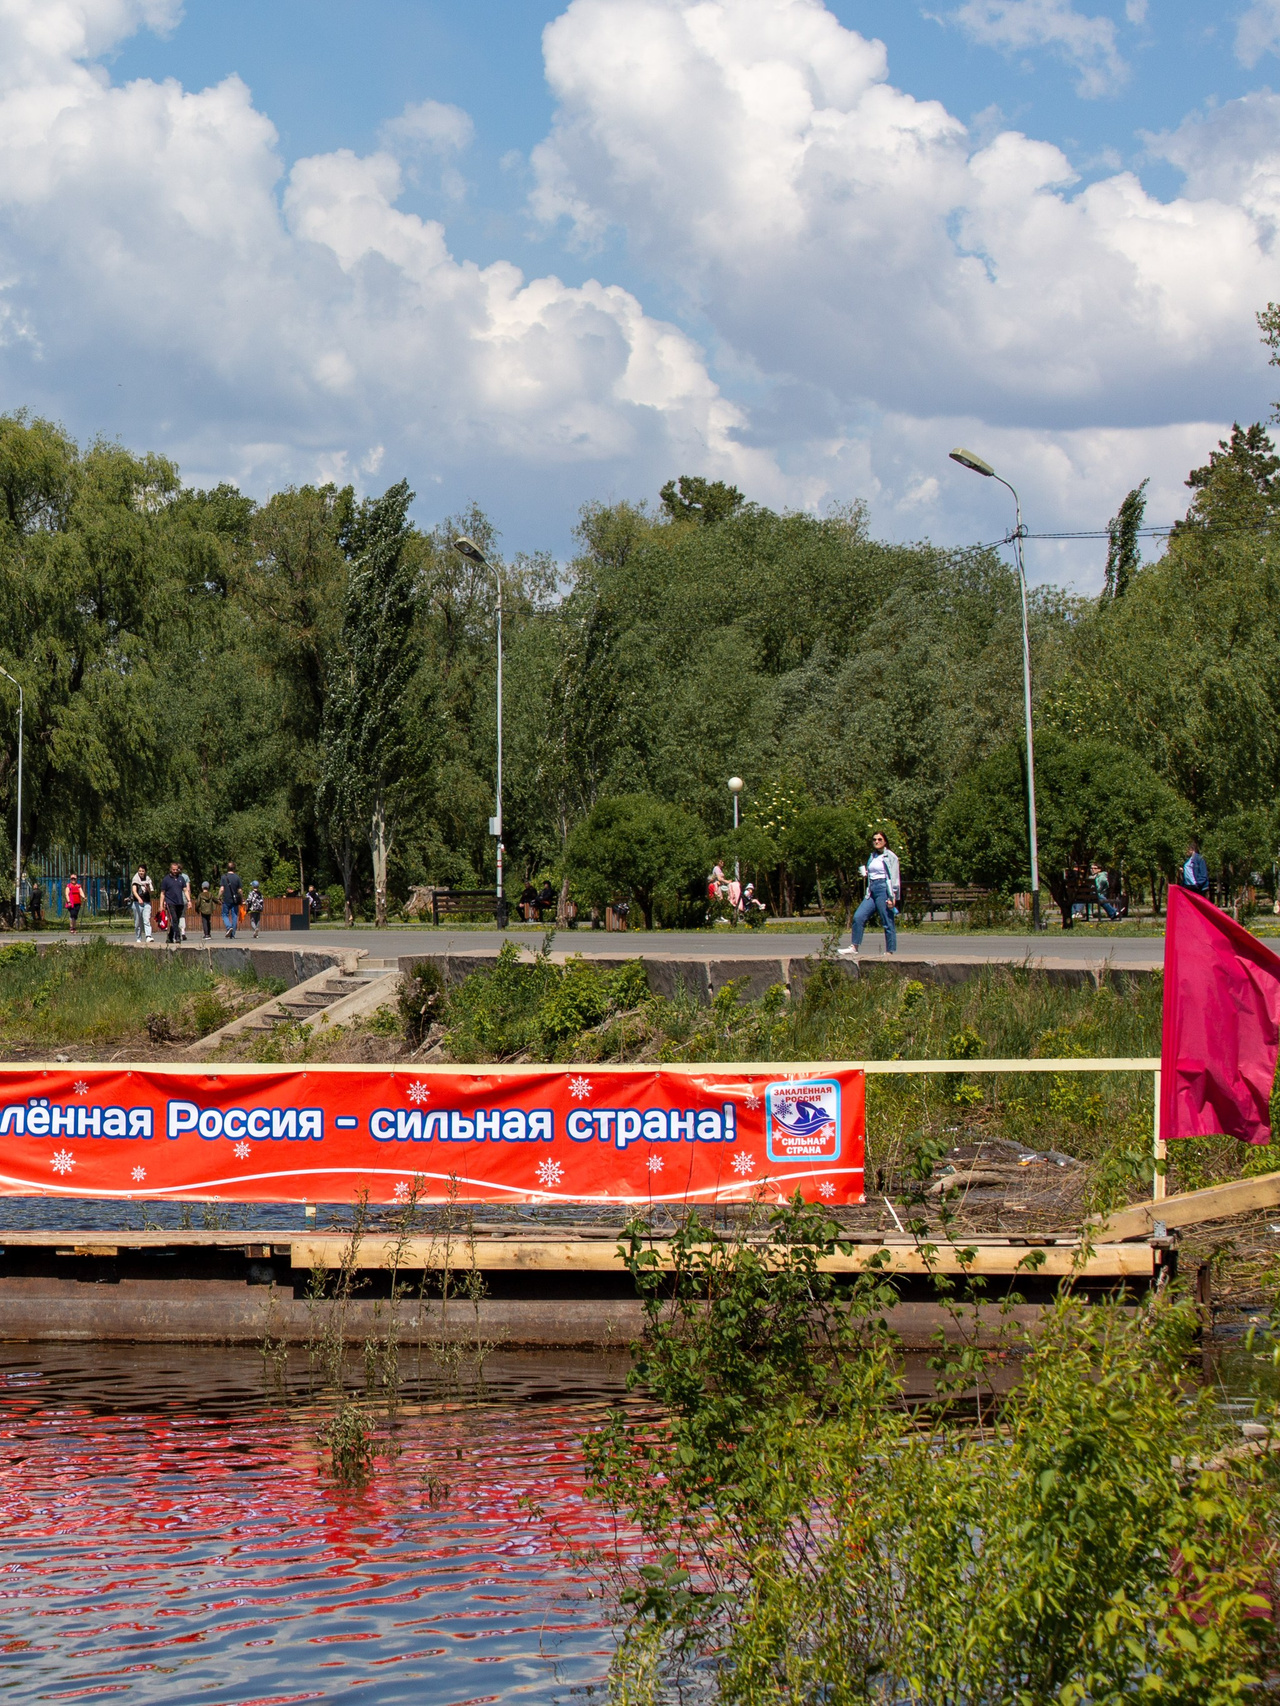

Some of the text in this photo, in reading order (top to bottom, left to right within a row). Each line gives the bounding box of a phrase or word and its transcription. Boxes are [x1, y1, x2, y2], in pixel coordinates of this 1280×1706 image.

[773, 1086, 832, 1096] ЗАКАЛЁННАЯ
[785, 1095, 822, 1103] РОССИЯ
[166, 1099, 324, 1141] Россия
[369, 1108, 553, 1143] сильная
[566, 1102, 736, 1150] страна!
[781, 1137, 826, 1146] СИЛЬНАЯ
[786, 1146, 822, 1154] СТРАНА
